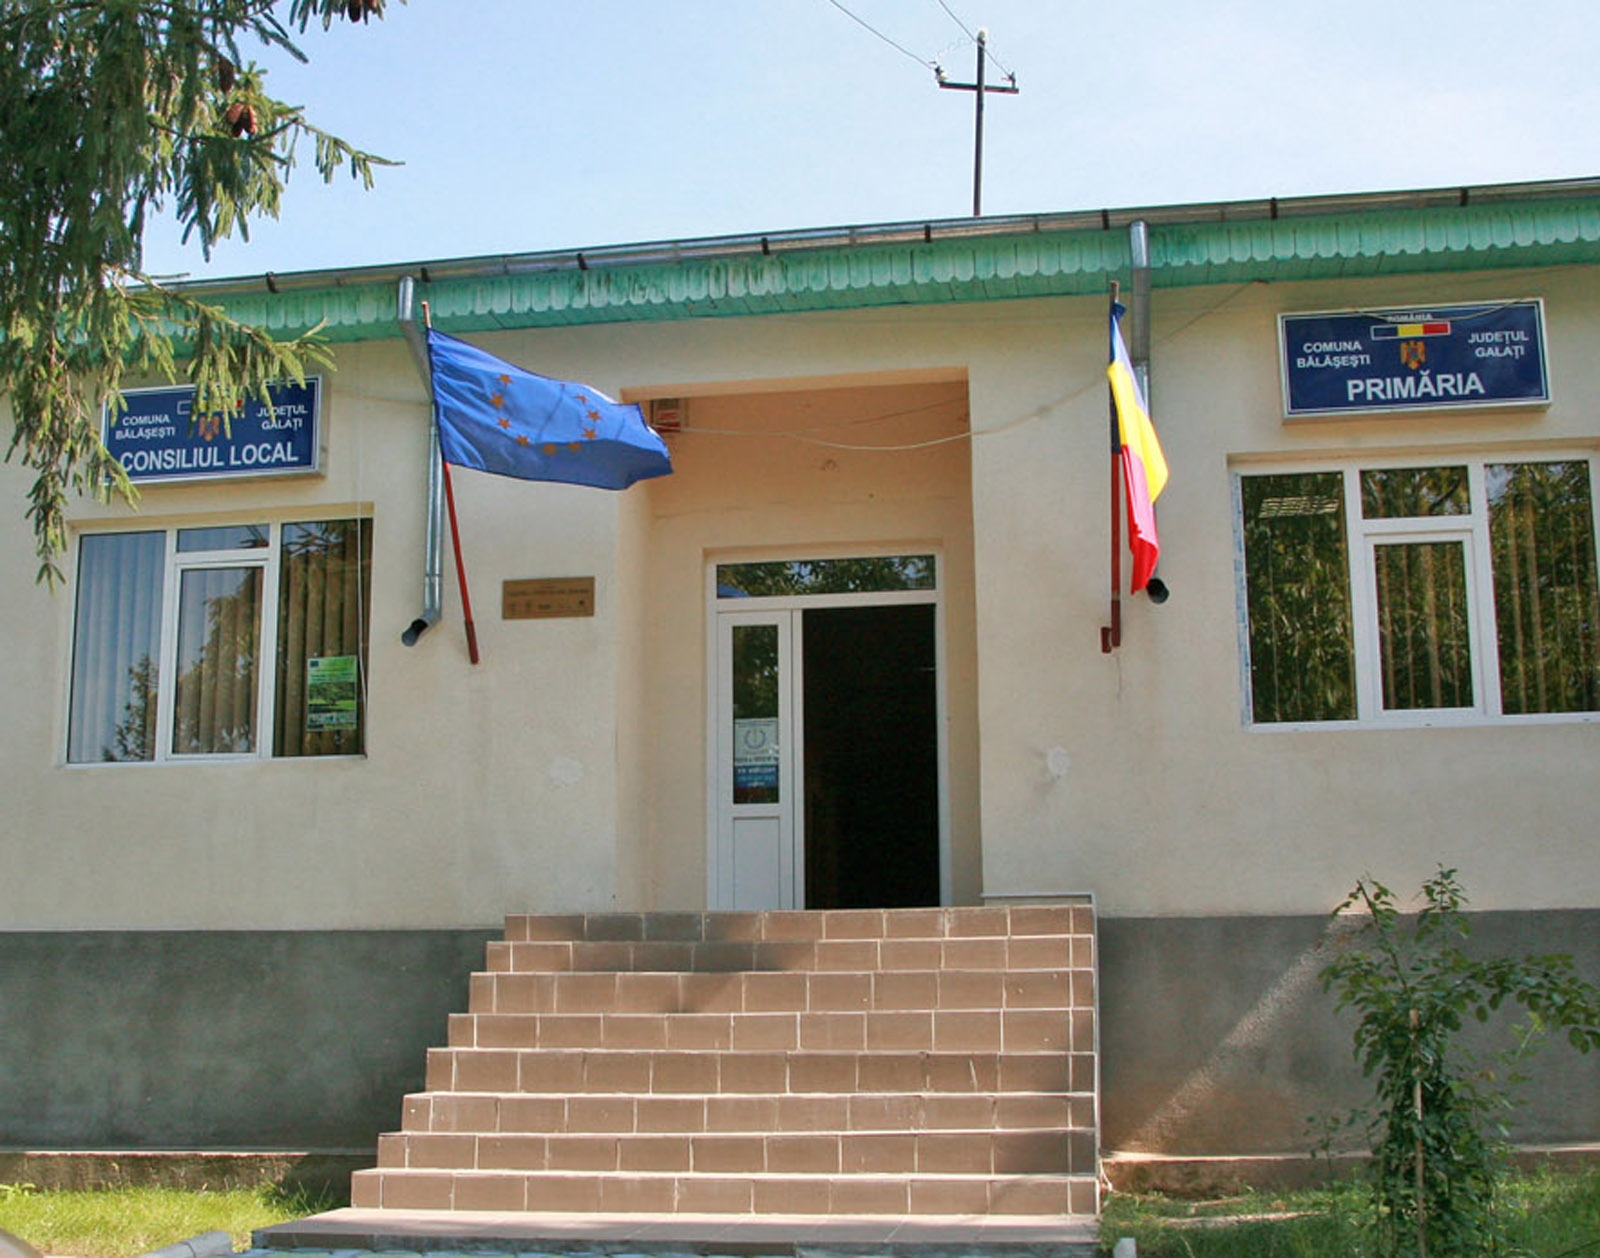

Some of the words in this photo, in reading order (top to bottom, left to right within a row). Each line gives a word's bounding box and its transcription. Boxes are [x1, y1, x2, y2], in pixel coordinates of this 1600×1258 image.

[1303, 341, 1362, 353] COMUNA
[1347, 370, 1485, 401] PRIMĂRIA
[122, 414, 170, 426] COMUNA
[120, 446, 224, 472] CONSILIUL
[230, 442, 298, 465] LOCAL
